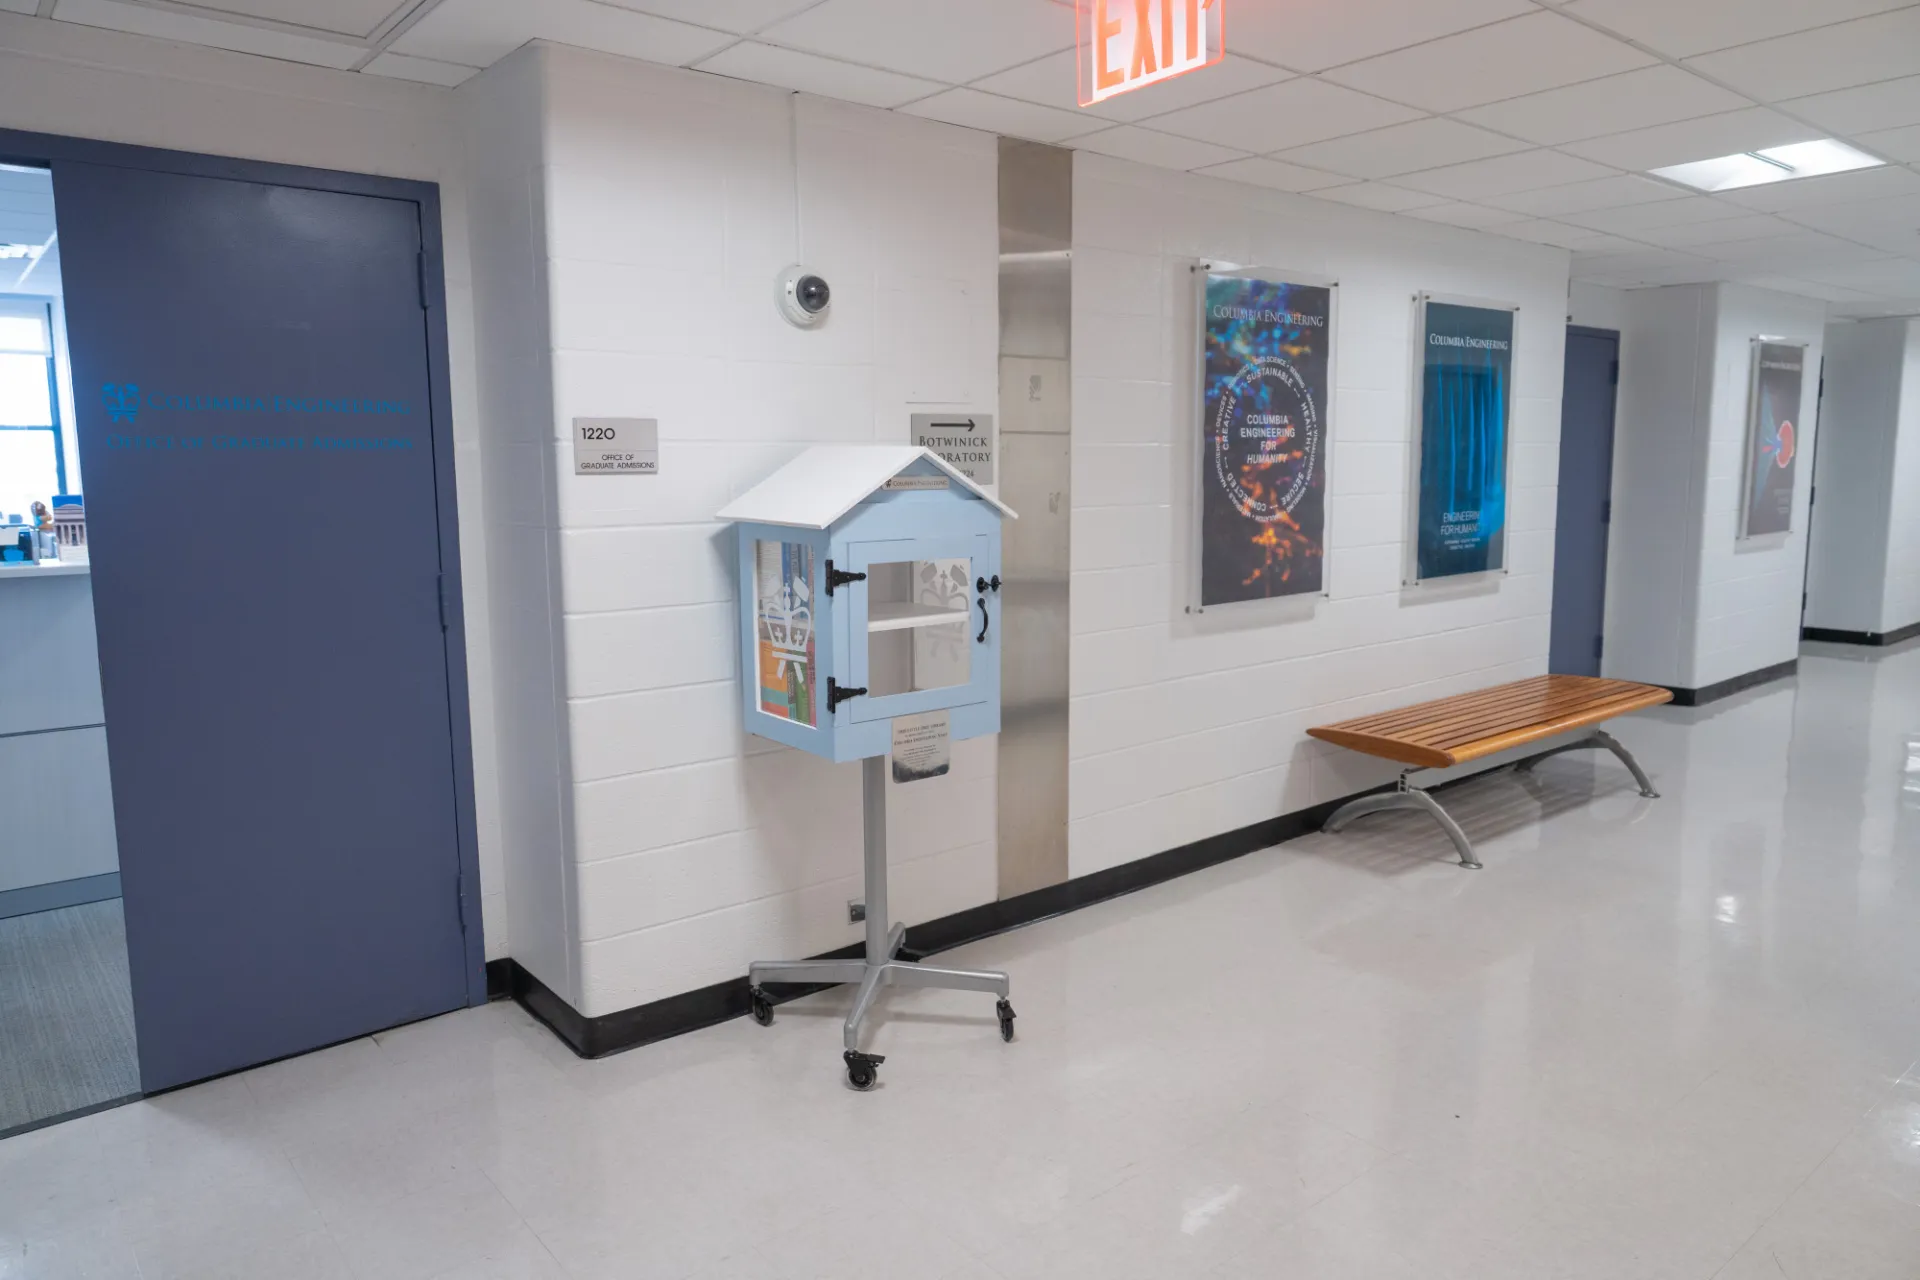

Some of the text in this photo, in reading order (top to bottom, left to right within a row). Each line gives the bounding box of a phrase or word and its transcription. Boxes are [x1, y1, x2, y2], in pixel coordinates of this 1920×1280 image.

[1213, 304, 1324, 327] COLUMBIA ENGINEERING
[1429, 332, 1508, 350] COLUMBIA ENGINEERING
[1246, 367, 1293, 388] SUSTAINABLE
[147, 391, 411, 415] COLUMBIA ENGINEERING
[1222, 396, 1237, 451] CREATIVE
[1247, 415, 1289, 425] COLUMBIA
[1300, 402, 1312, 452] HEALTHY
[581, 427, 616, 440] 1220
[1240, 427, 1296, 438] ENGINEERING
[106, 433, 413, 450] OFFICE OF GRADUATE ADMISSIONS
[919, 435, 989, 448] BOTWINICK
[1260, 441, 1277, 451] FOR
[601, 453, 635, 461] OFFICE OF
[937, 452, 991, 462] ORATORY
[1247, 453, 1289, 464] HUMANITY
[580, 461, 655, 470] GRADUATE ADMISSIONS
[1227, 472, 1267, 512] CONNECTED
[1281, 471, 1305, 505] SECURE
